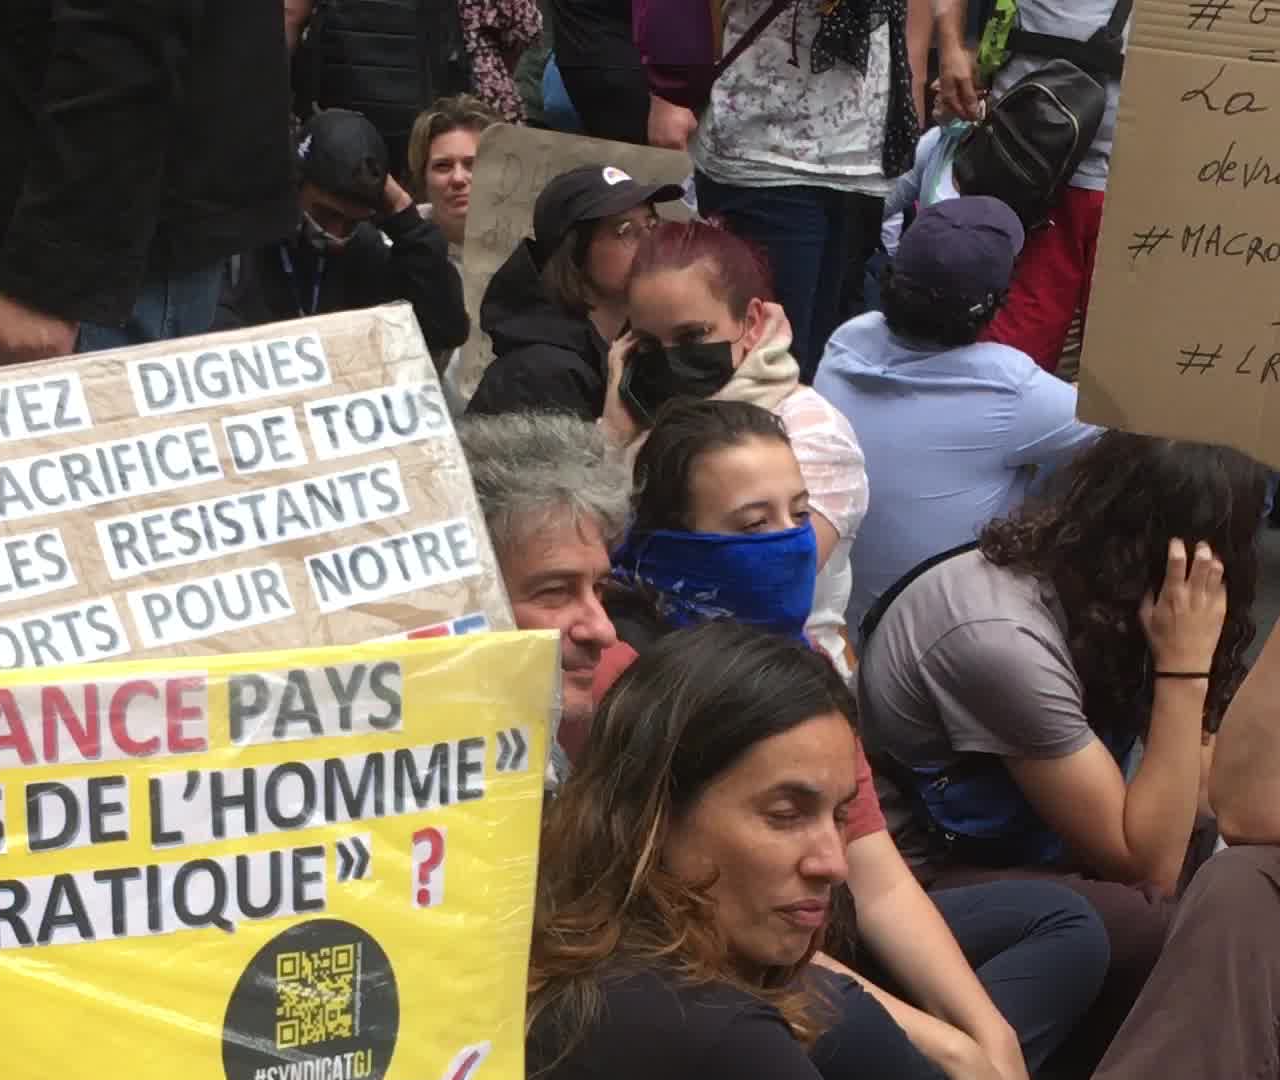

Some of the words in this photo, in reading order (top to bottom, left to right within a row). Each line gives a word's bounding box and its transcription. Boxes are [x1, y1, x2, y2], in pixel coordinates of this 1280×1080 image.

[1182, 63, 1266, 113] La
[136, 337, 328, 410] DIGNES
[229, 421, 293, 473] DE
[313, 383, 446, 450] TOUS
[110, 469, 402, 569] RESISTANTS
[147, 567, 292, 638] POUR
[308, 522, 477, 604] NOTRE
[228, 662, 402, 744] PAYS
[26, 776, 127, 850] DE
[411, 828, 444, 906] ?
